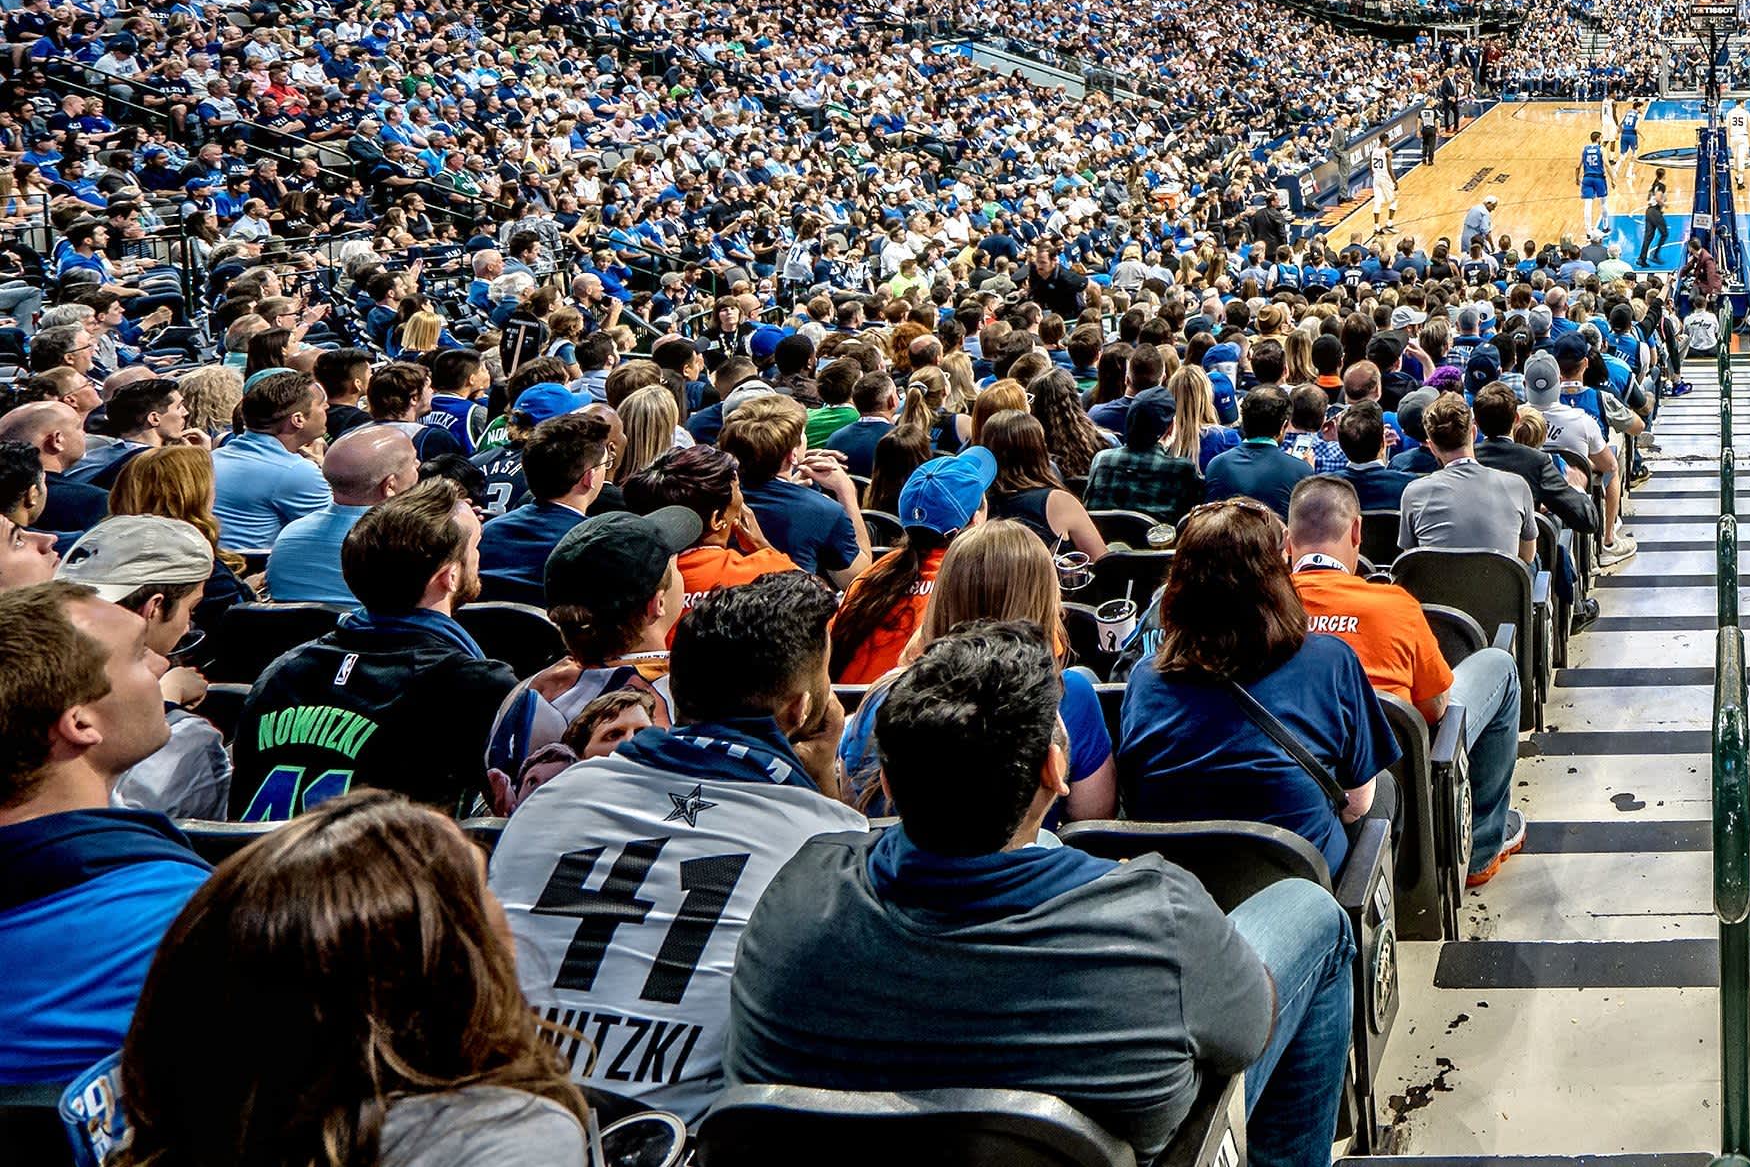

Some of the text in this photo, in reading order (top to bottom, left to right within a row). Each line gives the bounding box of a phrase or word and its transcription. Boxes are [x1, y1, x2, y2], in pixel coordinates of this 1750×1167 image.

[1731, 116, 1744, 126] 35
[1372, 157, 1384, 169] 20
[1585, 154, 1598, 166] 42
[258, 705, 379, 760] NOWITZKI
[529, 836, 751, 1004] 41
